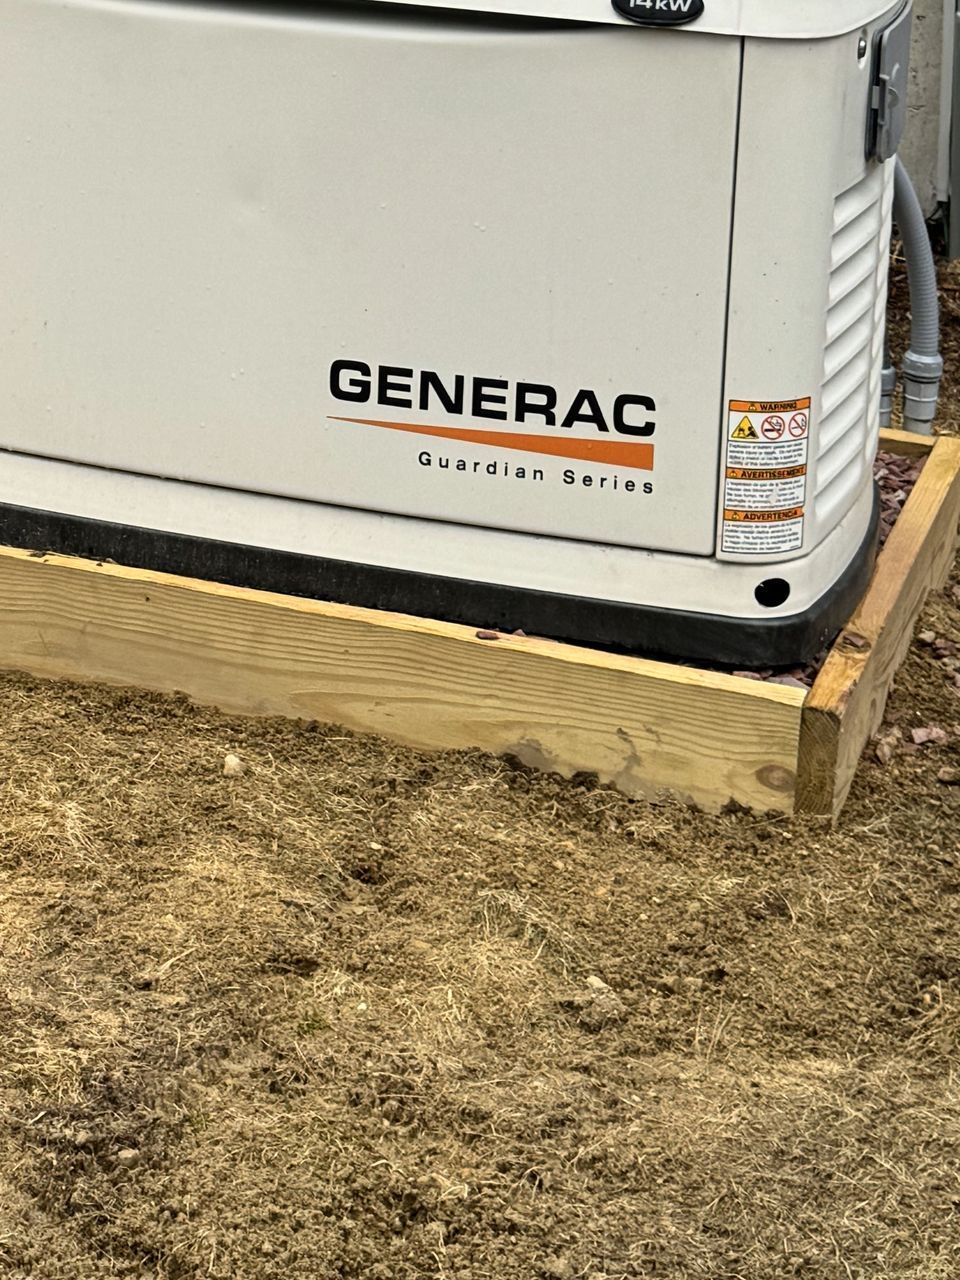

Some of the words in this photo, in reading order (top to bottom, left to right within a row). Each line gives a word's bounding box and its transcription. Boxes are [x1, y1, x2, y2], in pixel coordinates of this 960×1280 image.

[329, 359, 657, 438] GENERAC
[760, 402, 797, 411] WARNING
[417, 451, 545, 482] Guardian
[562, 469, 654, 495] Series
